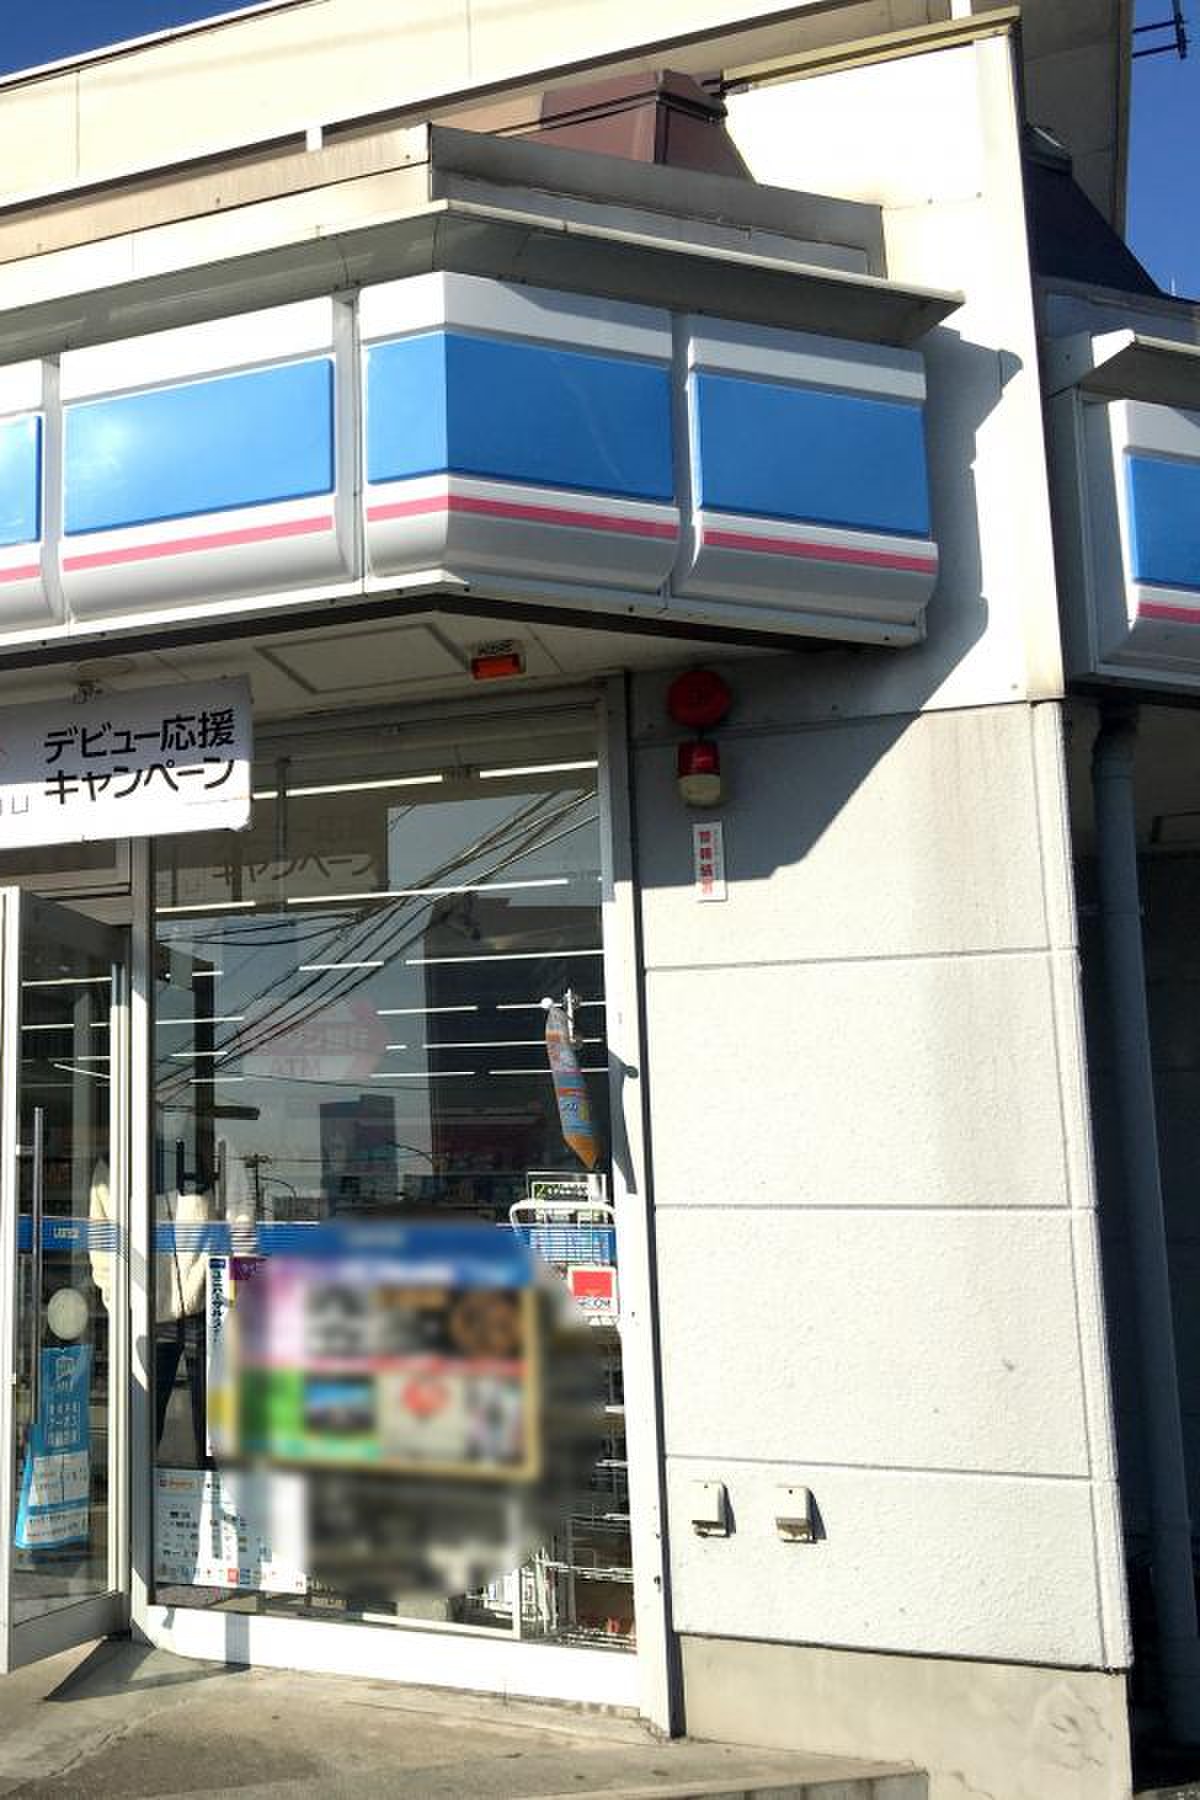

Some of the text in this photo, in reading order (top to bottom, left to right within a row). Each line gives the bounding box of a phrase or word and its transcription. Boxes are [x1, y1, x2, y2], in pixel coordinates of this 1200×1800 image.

[44, 707, 235, 764] デビュー応援
[44, 757, 235, 805] キャンペーン
